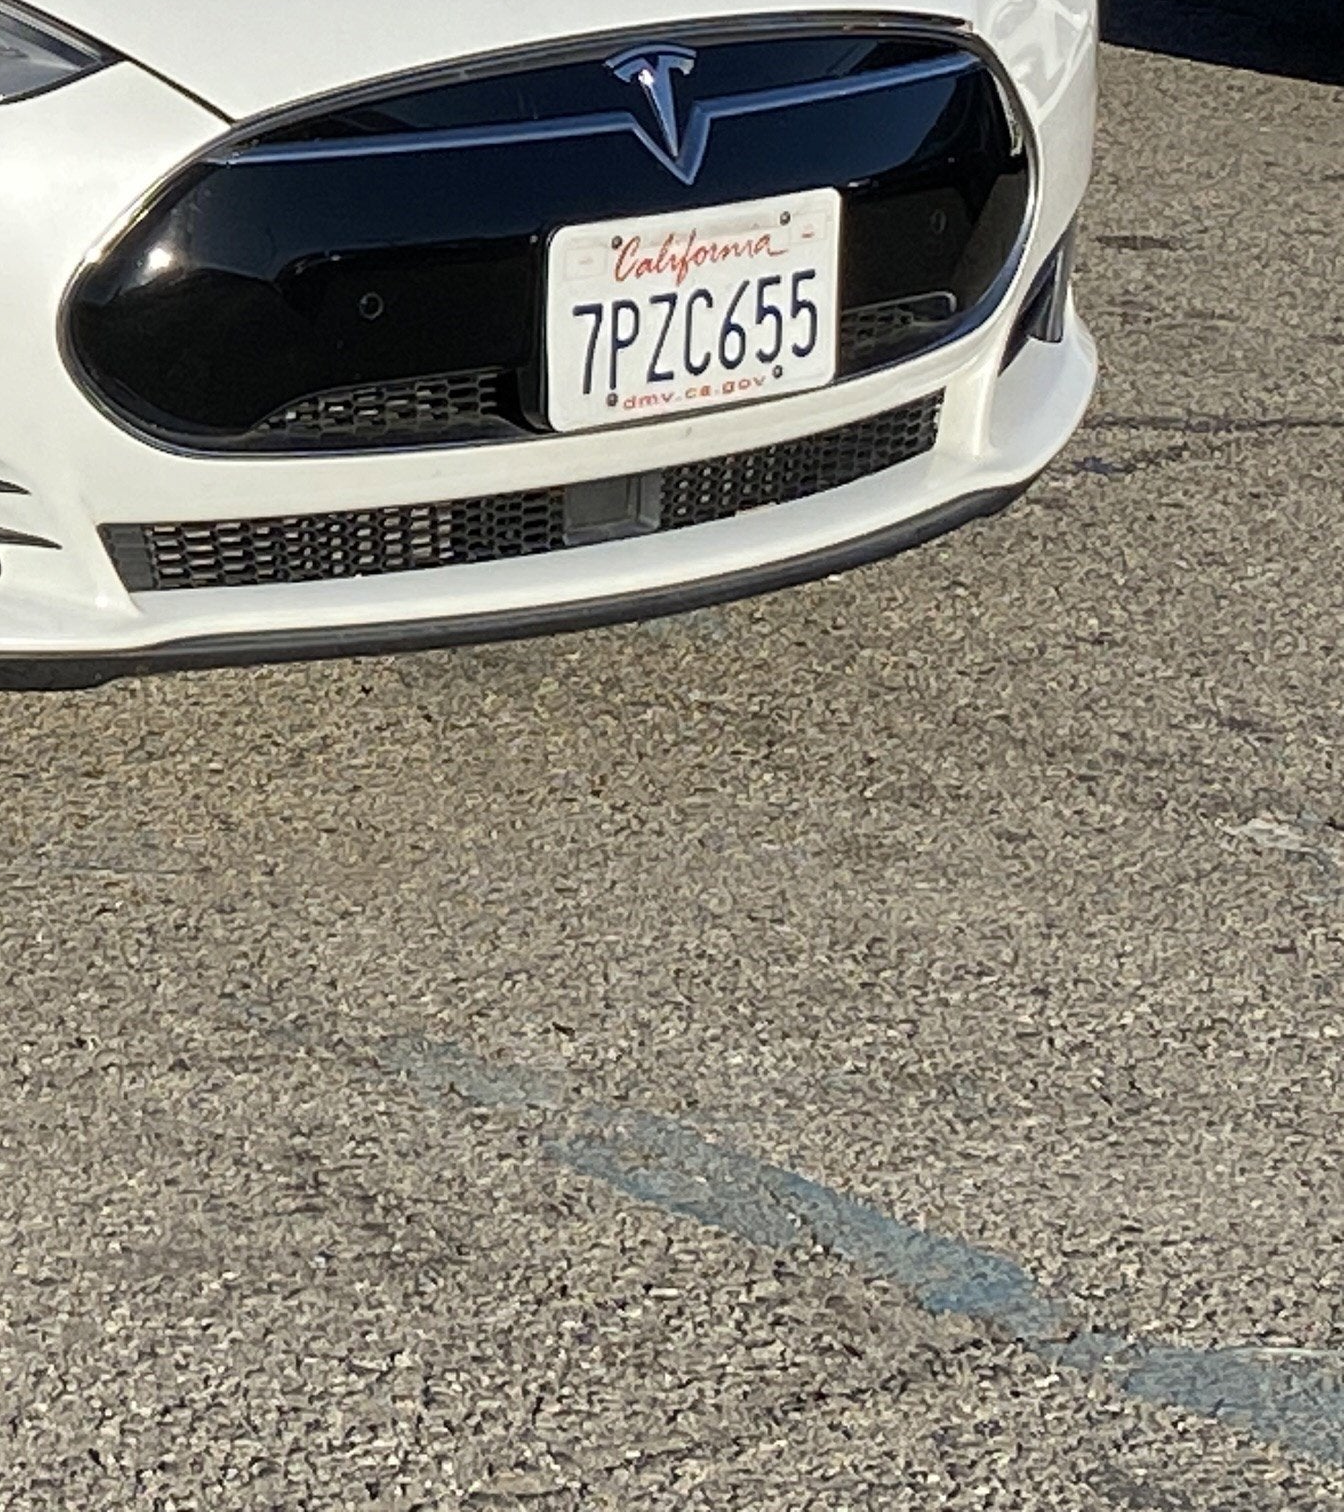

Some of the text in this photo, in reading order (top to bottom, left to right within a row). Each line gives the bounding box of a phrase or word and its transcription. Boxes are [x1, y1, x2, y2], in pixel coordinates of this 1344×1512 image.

[614, 228, 787, 286] California
[572, 268, 818, 395] 7PZC655
[623, 374, 767, 410] dmv.ca.gov
